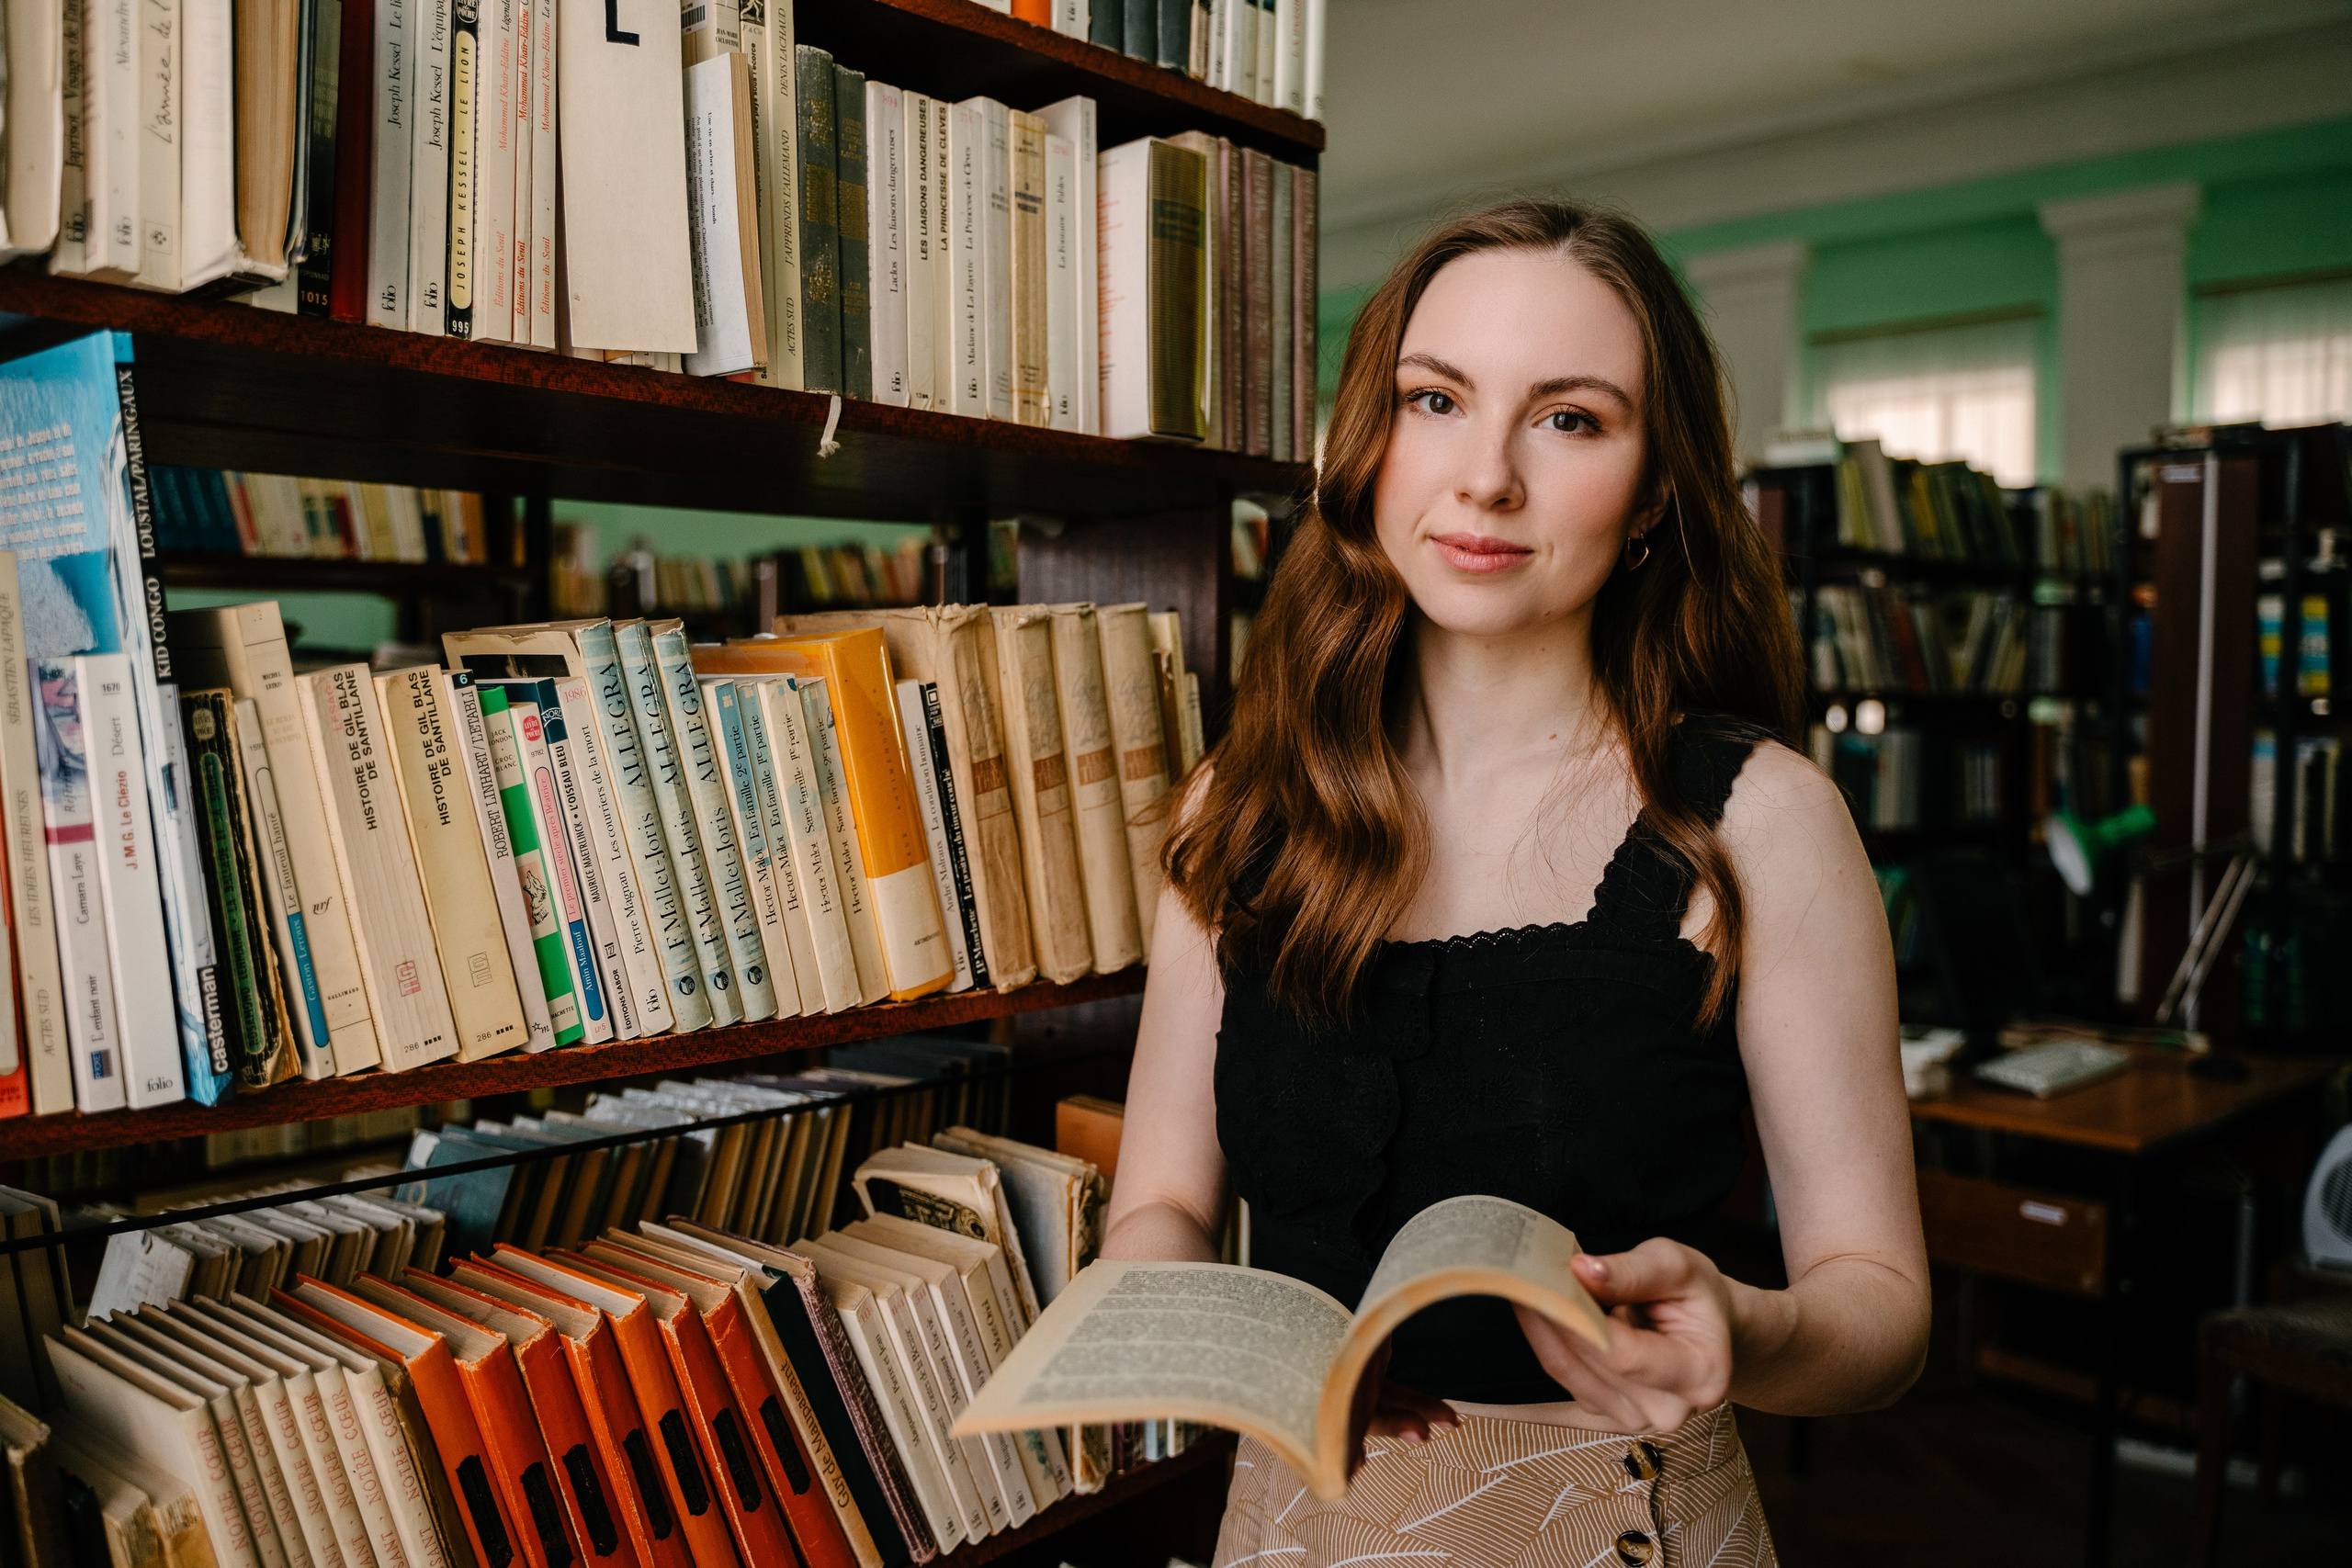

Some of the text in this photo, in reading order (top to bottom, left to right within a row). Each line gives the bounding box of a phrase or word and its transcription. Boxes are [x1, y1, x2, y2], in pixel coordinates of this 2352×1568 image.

[499, 38, 510, 152] Mohammed Khaïr-Eddine
[382, 8, 402, 312] folio Joseph Kessel Le
[424, 65, 444, 309] folio Joseph Kessel
[457, 47, 469, 290] JOSEPH KESSEL LION
[516, 8, 529, 317] Éditions Mohammed Khaïr-Eddine
[542, 22, 551, 315] Éditions Mohammed Khaïr-Eddine
[777, 7, 797, 355] ACTES SUD J'APPRENDS L'ALLEMAND DENIS LACHAUD
[888, 129, 899, 293] Laclos Les liaisons dangereuses
[919, 98, 928, 261] LES LIAISONS DANGEREUSES
[939, 106, 948, 251] LA PRINCESSE DE CLEVES
[300, 289, 329, 306] 1015
[452, 320, 469, 334] 995
[965, 192, 976, 366] Madame Fayette Princesse
[119, 369, 172, 678] KID CONGO LOUSTAL/PARINGAUX
[345, 669, 379, 780] DE SANTILLANE
[419, 669, 452, 777] DE SANTILLANE
[460, 673, 469, 684] 6
[491, 728, 507, 739] JACK
[564, 686, 587, 704] 1986
[599, 661, 646, 788] ALLEGRA
[638, 661, 681, 786] ALLEGRA
[674, 661, 718, 784] ALLEGRA
[334, 671, 378, 830] HISTOIRE DE GIL BLAS
[408, 671, 451, 826] HISTOIRE DE GIL BLAS
[476, 750, 509, 860] ROBERT LINHART
[495, 761, 517, 773] BLANC
[530, 749, 544, 758] 9782
[555, 745, 569, 769] BLEU
[560, 770, 579, 811] L'OISEAU
[582, 725, 661, 1014] folio Pierre Magnan Les courriers de la mort
[731, 725, 778, 927] Hector Malot En famille partie
[752, 714, 799, 912] Hector Malot En famille partie
[785, 713, 833, 916] Hector Malot Sans famille partie
[826, 768, 863, 915] Hector Malot Sans famille
[914, 725, 956, 912] André Malraux condition humaine
[72, 852, 90, 925] Camara Laye
[112, 716, 174, 1093] folio Clézio Désert
[277, 849, 317, 1002] Gaston Leroux Le fauteuil
[312, 897, 333, 915] nrf
[560, 867, 594, 992] Amin Maalouf premier
[585, 869, 602, 903] MAURICE
[40, 1013, 55, 1056] ACTES
[202, 967, 229, 1073] casterman
[327, 986, 360, 1001] GALLIMARD
[404, 1042, 420, 1053] 286
[477, 1031, 492, 1043] 286
[613, 968, 633, 1030] ÉDITIONS LABOR
[244, 1402, 293, 1525] NOTRE CŒUR
[274, 1395, 322, 1517] NOTRE CŒUR
[303, 1392, 353, 1510] NOTRE CŒUR
[332, 1389, 358, 1441] CŒUR
[372, 1384, 399, 1438] CŒUR
[780, 1358, 851, 1509] Guy de Maupassant
[198, 1424, 249, 1551] NOTRE CŒUR
[220, 1414, 272, 1540] NOTRE CŒUR
[352, 1449, 382, 1506] NOTRE
[392, 1445, 422, 1502] NOTRE
